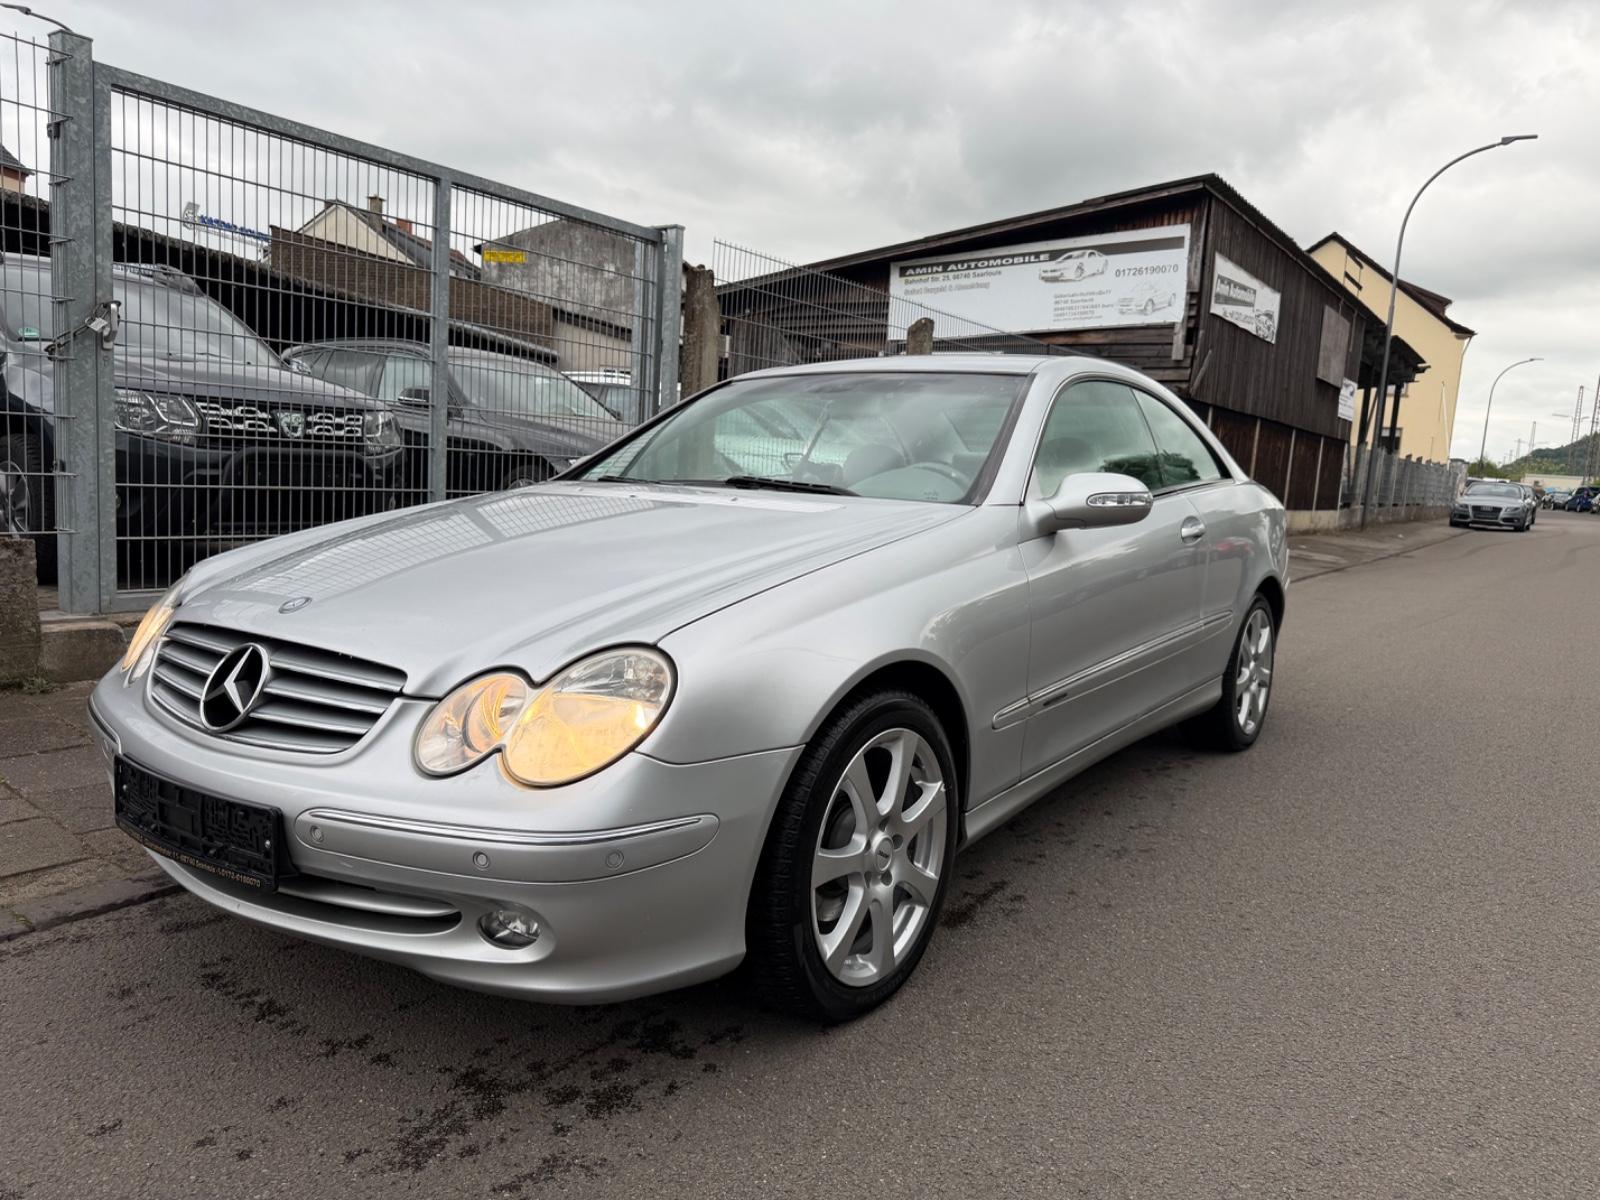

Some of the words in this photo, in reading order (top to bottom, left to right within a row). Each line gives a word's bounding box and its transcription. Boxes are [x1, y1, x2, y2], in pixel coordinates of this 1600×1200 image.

[905, 264, 946, 276] AMIN
[947, 253, 1050, 271] AUTOMOBILE
[1115, 264, 1179, 277] 01726190070
